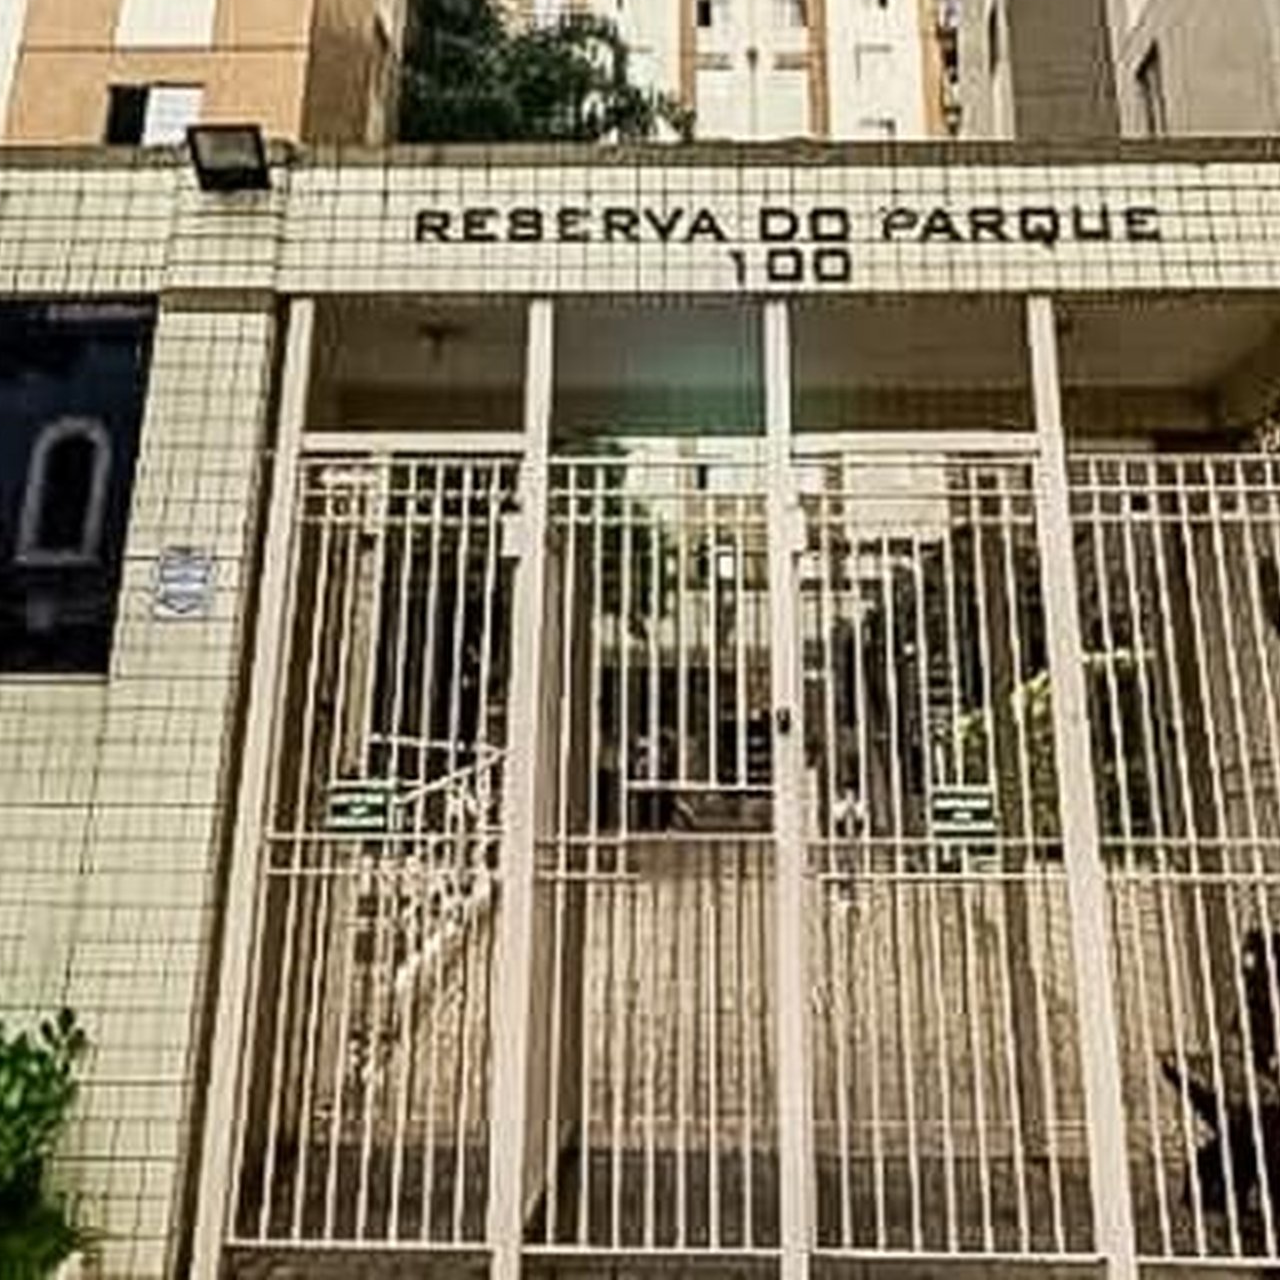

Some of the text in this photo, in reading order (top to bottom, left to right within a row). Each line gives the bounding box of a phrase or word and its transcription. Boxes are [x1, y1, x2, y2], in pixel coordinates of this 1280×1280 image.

[415, 203, 1162, 251] RESERVA DO PARQUE
[728, 248, 852, 285] 100
